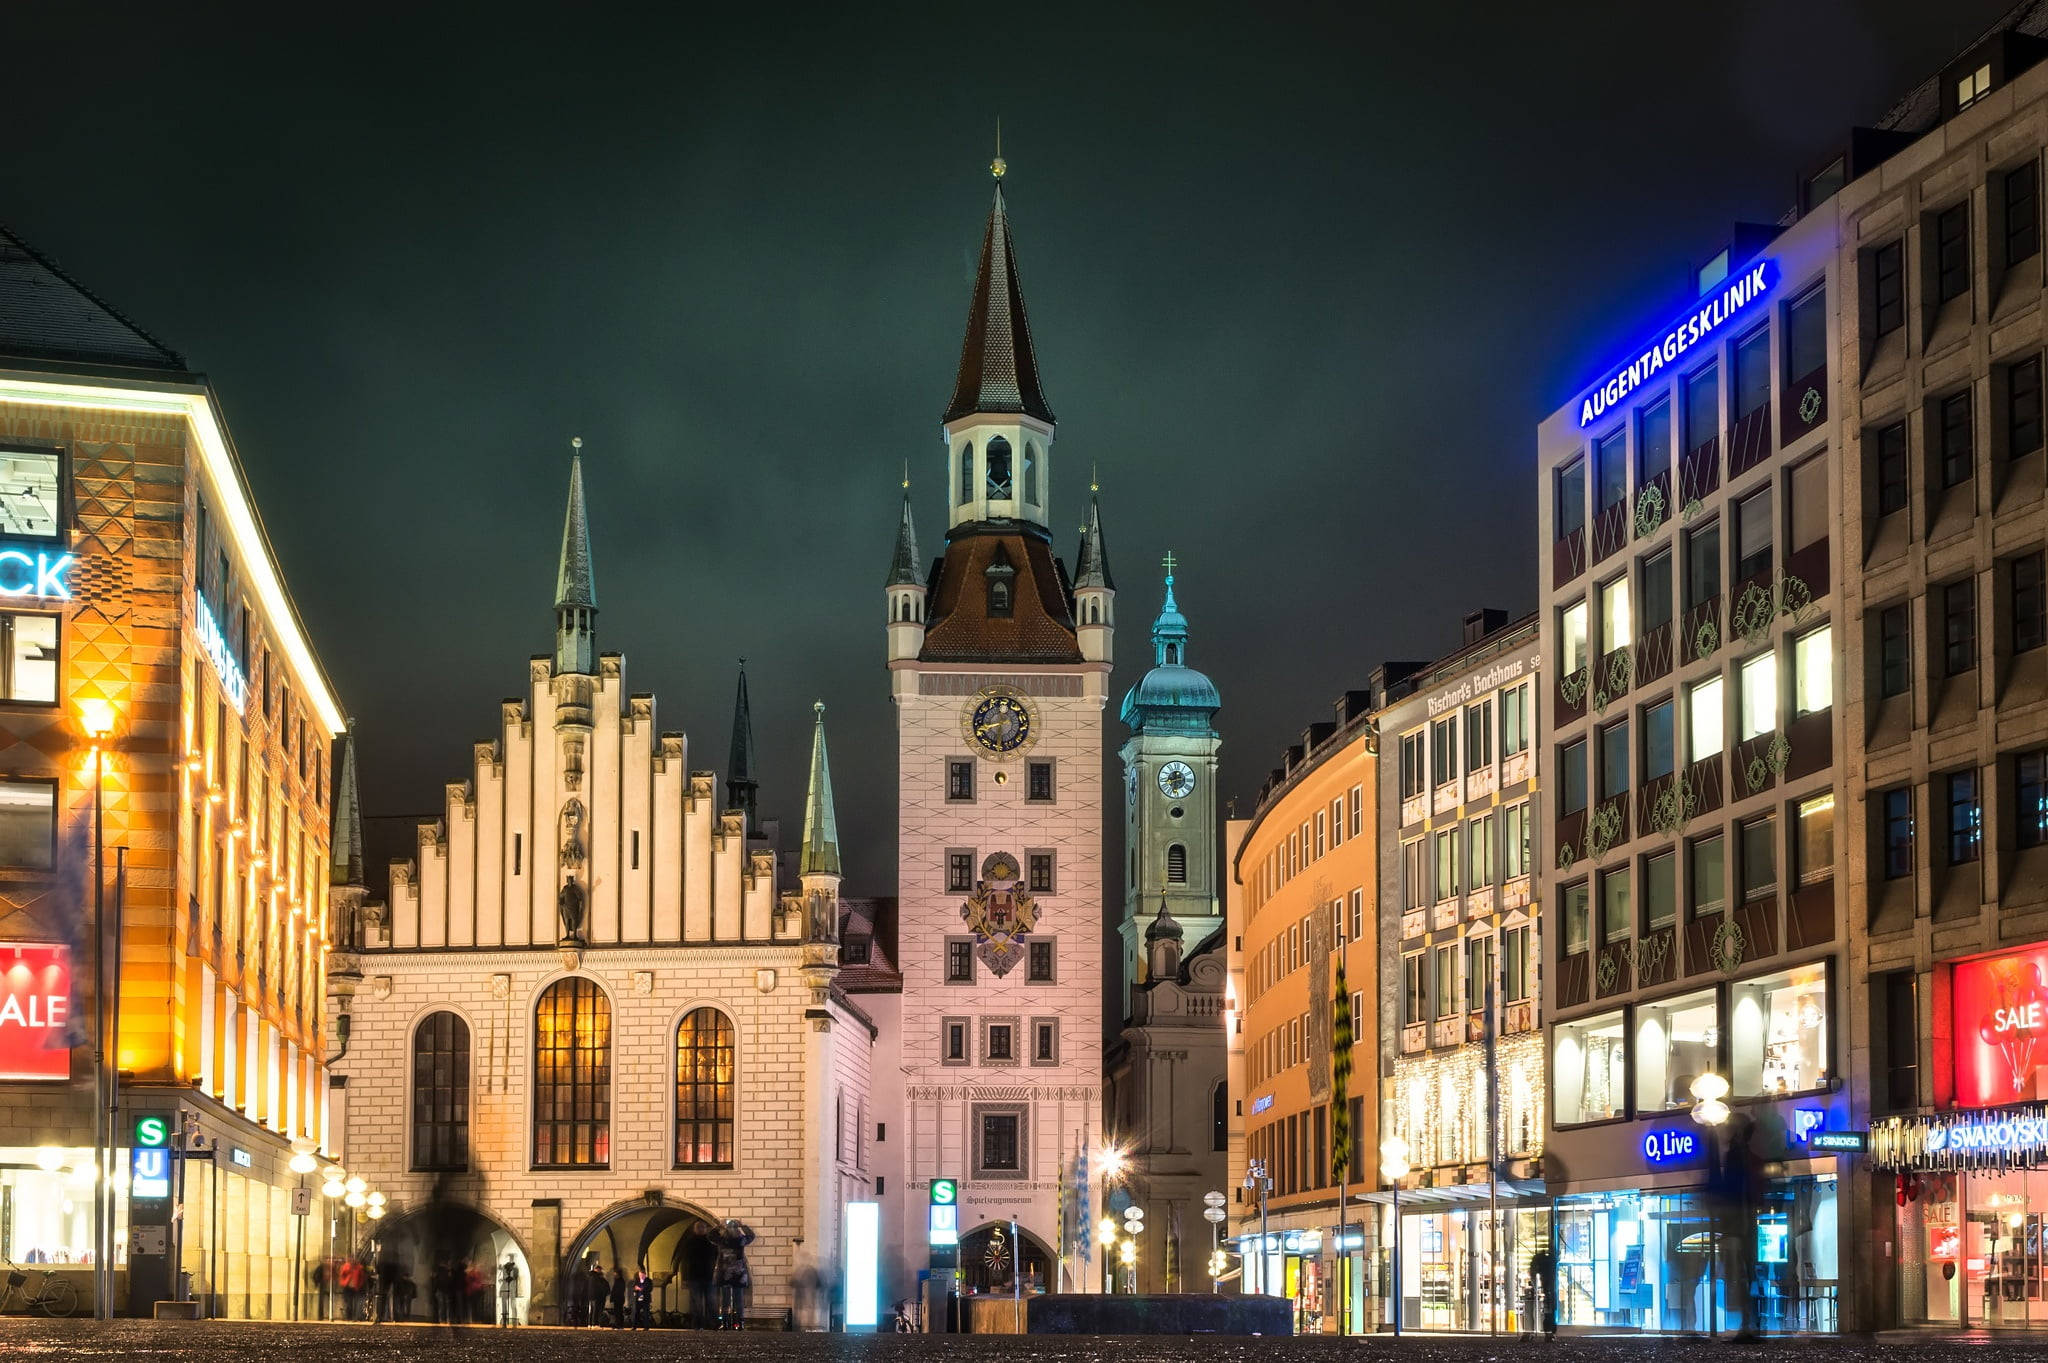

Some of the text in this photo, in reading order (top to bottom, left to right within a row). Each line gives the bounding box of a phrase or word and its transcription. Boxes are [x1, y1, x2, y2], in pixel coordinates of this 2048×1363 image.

[1581, 263, 1767, 427] AUGENTAGESKLINIK
[1994, 1001, 2041, 1032] SALE
[140, 1119, 163, 1146] S
[1663, 1131, 1693, 1156] Live
[1951, 1118, 2048, 1149] SWAROVSKI
[140, 1151, 161, 1177] U
[934, 1180, 954, 1204] S
[1923, 1207, 1951, 1223] SALE
